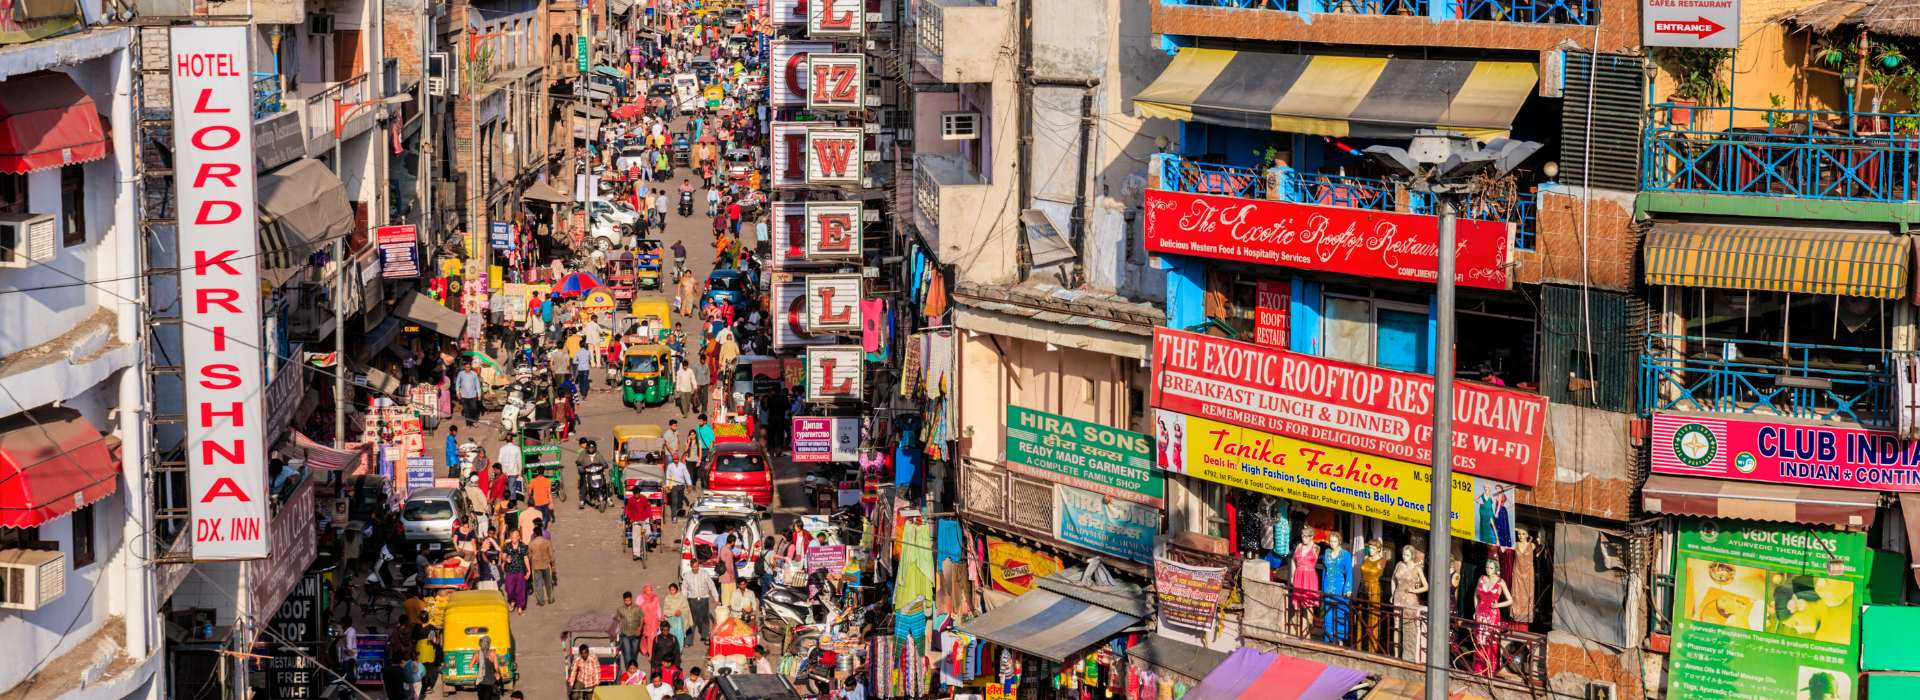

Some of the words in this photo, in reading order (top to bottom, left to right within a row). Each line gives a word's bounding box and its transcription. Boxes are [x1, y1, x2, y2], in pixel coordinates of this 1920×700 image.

[1656, 23, 1712, 32] ENTRANCE
[177, 53, 240, 77] HOTEL
[191, 88, 242, 225] LORD
[1179, 199, 1218, 233] The
[1220, 203, 1296, 245] Exotic
[1300, 212, 1364, 263] Rooftop
[1365, 219, 1468, 269] Restaurt
[1160, 238, 1190, 250] Delicious
[1190, 241, 1218, 253] Western
[1218, 245, 1235, 255] Food
[1236, 246, 1242, 256] &
[1243, 247, 1280, 262] Hospitality
[1281, 251, 1311, 264] Services
[194, 250, 252, 503] KRISHNA
[1159, 333, 1199, 370] THE
[1202, 342, 1278, 387] EXOTIC
[1280, 357, 1384, 407] ROOFTOP
[1387, 376, 1540, 437] RESURANT
[1020, 411, 1077, 438] HIRA
[1083, 426, 1150, 454] SONS
[1164, 374, 1255, 406] BREAKFAST
[1258, 393, 1314, 419] LUNCH
[1318, 405, 1332, 422] &
[1336, 409, 1405, 437] DINNER
[1414, 423, 1468, 449] (FEE
[1472, 433, 1531, 465] WI-FI)
[1201, 403, 1267, 427] REMEMBER
[1268, 417, 1283, 431] US
[1285, 421, 1309, 436] FOR
[1311, 428, 1376, 450] DELICIOUS
[1378, 439, 1414, 457] FOOD
[1416, 446, 1477, 470] SECES
[1758, 425, 1837, 462] CLUB
[1019, 441, 1054, 458] READY
[1055, 449, 1086, 467] MADE
[1088, 458, 1150, 482] GARMENTS
[1026, 455, 1033, 464] A
[1033, 457, 1080, 475] COMPLETE
[1083, 469, 1115, 484] FAMILY
[1116, 476, 1142, 490] SHOP
[1209, 429, 1288, 466] Tanika
[1299, 447, 1399, 491] Fashion
[1780, 461, 1840, 481] INDIAN
[1203, 454, 1225, 467] Deals
[1227, 459, 1238, 470] In:
[1241, 462, 1261, 476] High
[1263, 467, 1295, 483] Fashion
[1296, 474, 1328, 491] Sequins
[1329, 481, 1371, 499] Garments
[1373, 491, 1395, 506] Belly
[1397, 496, 1425, 512] Dance
[1413, 471, 1422, 481] M.
[1287, 487, 1302, 496] Main
[1321, 495, 1340, 505] Pahar
[196, 518, 225, 542] DX.
[230, 517, 260, 541] INN
[1728, 540, 1773, 551] AYURVEDIC
[293, 577, 315, 597] AM
[276, 600, 311, 619] OOF
[278, 622, 306, 641] TOP
[277, 672, 310, 683] FREE
[279, 686, 310, 699] WI-FI
